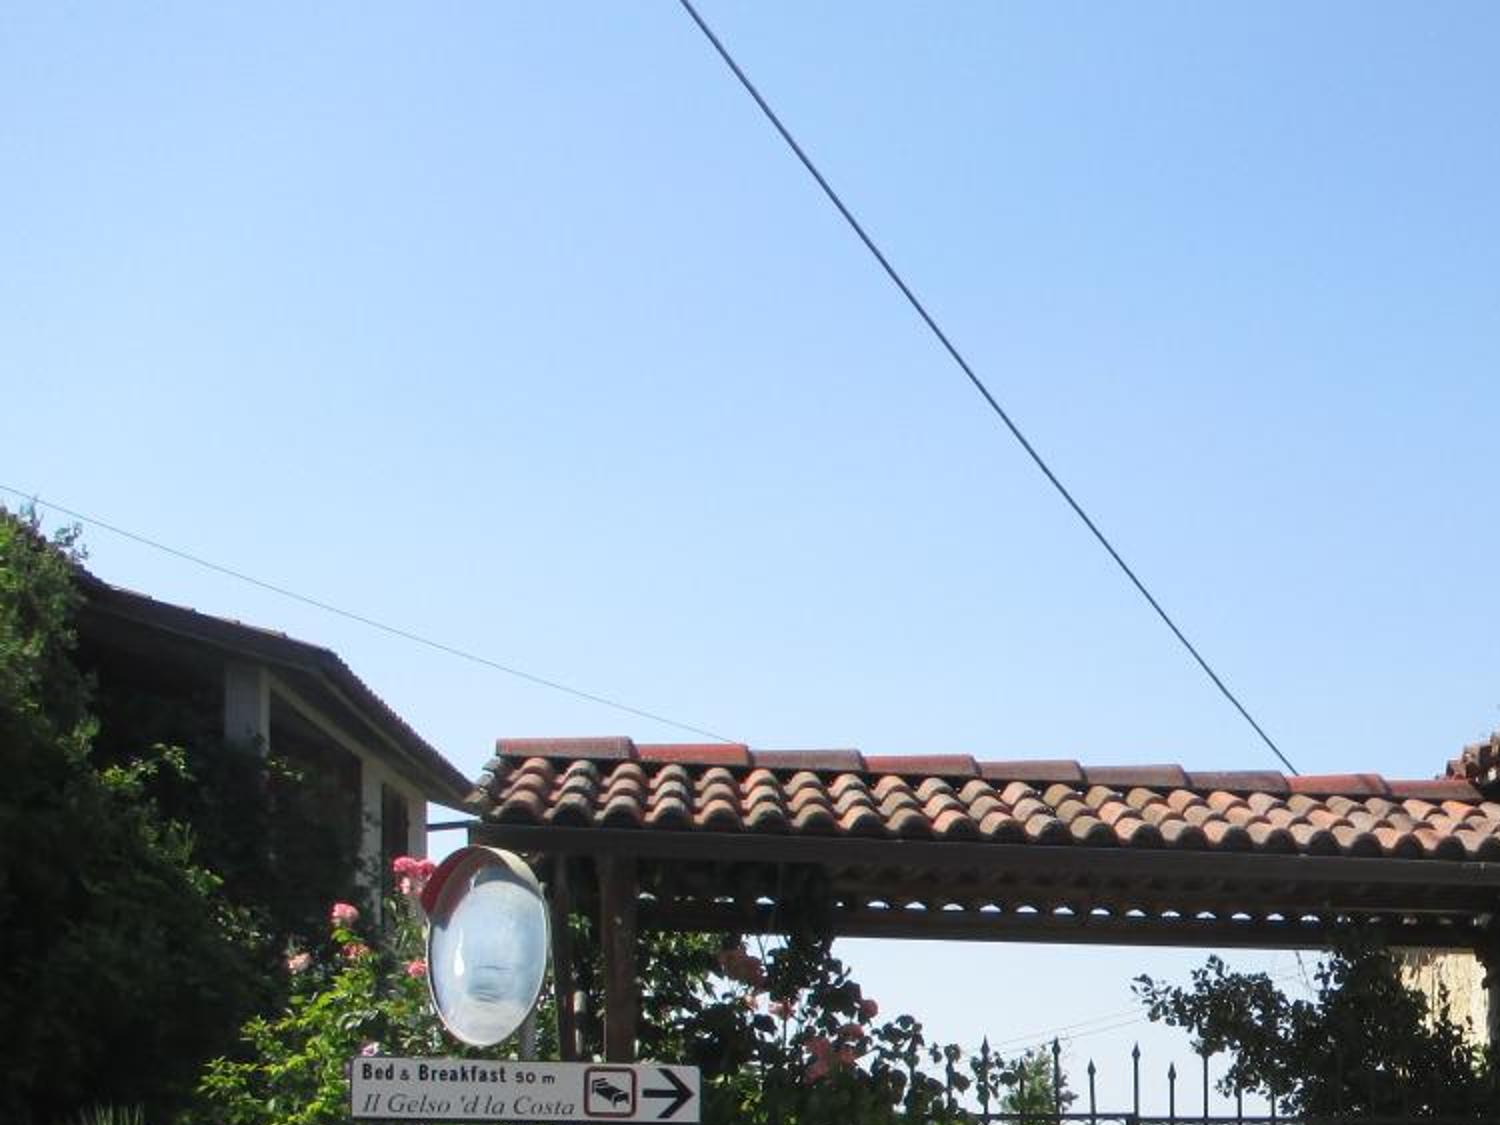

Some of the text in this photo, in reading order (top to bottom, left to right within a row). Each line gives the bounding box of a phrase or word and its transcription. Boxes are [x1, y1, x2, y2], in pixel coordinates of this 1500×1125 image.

[362, 1063, 555, 1085] Bed & Breakfast 50 m
[363, 1093, 381, 1113] Il
[387, 1093, 452, 1113] Gelso
[513, 1095, 576, 1115] Costa
